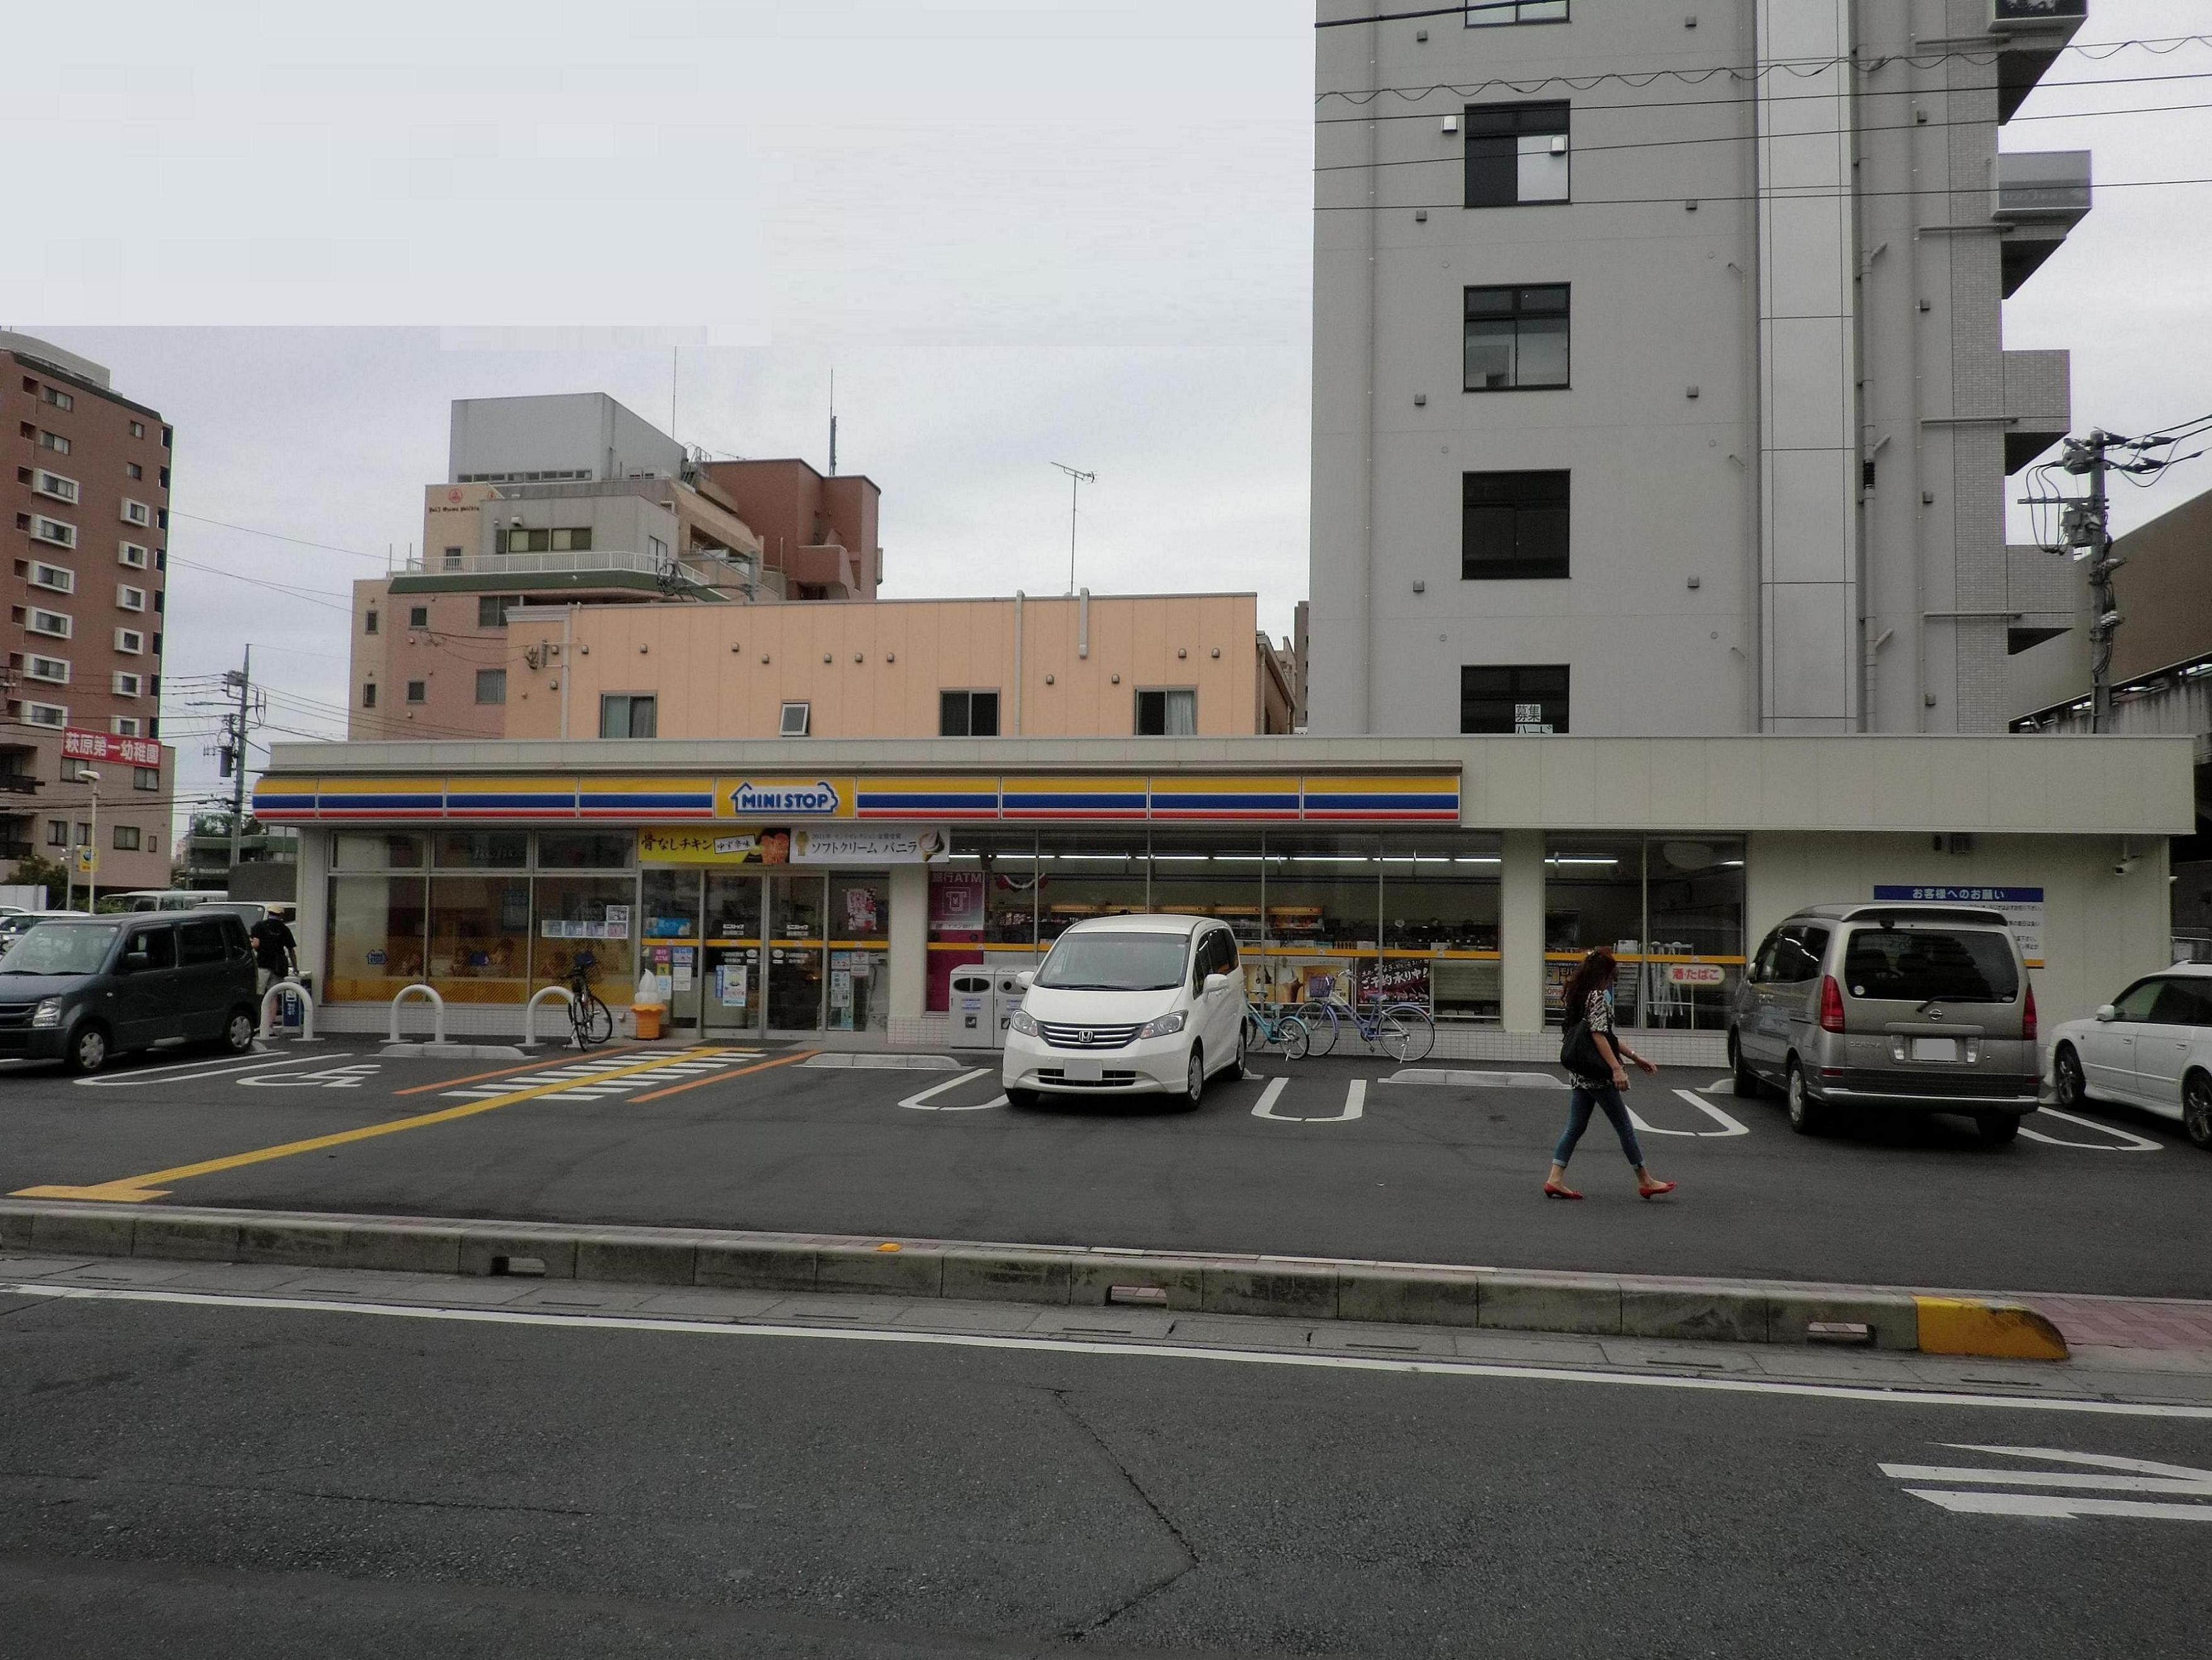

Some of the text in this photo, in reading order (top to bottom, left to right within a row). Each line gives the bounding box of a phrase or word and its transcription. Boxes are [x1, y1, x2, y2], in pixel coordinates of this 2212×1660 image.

[1516, 705, 1540, 722] 募集
[742, 793, 828, 808] MINI STOP
[641, 833, 712, 851] 骨なしチキン
[812, 841, 917, 854] ソフトクリーム バニラ
[1912, 888, 2005, 900] お客様へのお願い
